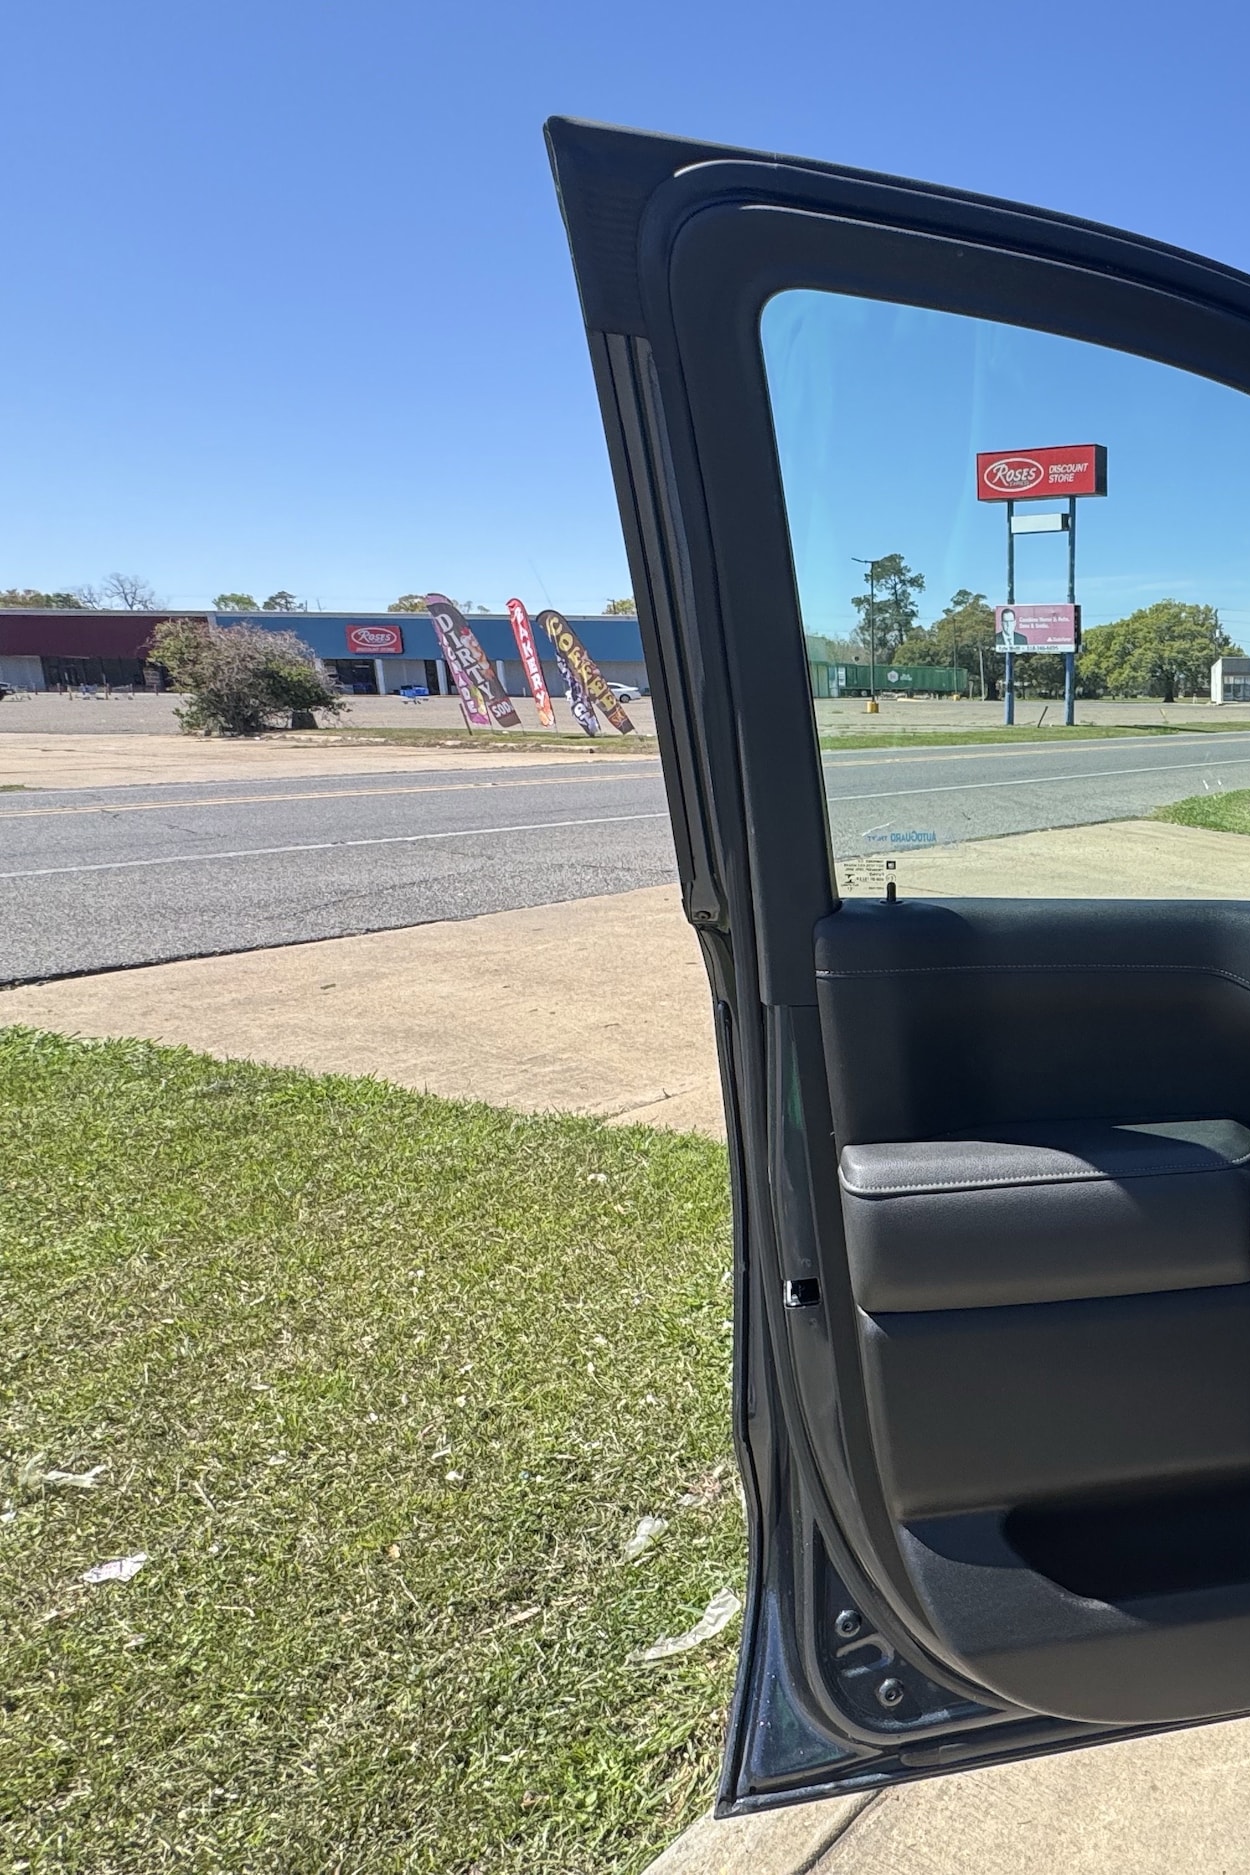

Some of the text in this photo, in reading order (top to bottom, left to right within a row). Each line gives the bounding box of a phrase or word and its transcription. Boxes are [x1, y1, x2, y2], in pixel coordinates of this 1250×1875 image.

[992, 464, 1037, 486] ROSES
[1049, 463, 1089, 474] DISCOUNT
[1048, 473, 1075, 483] STORE
[358, 630, 391, 643] ROSES
[436, 613, 495, 700] DIRTY
[514, 606, 546, 708] BAKERY
